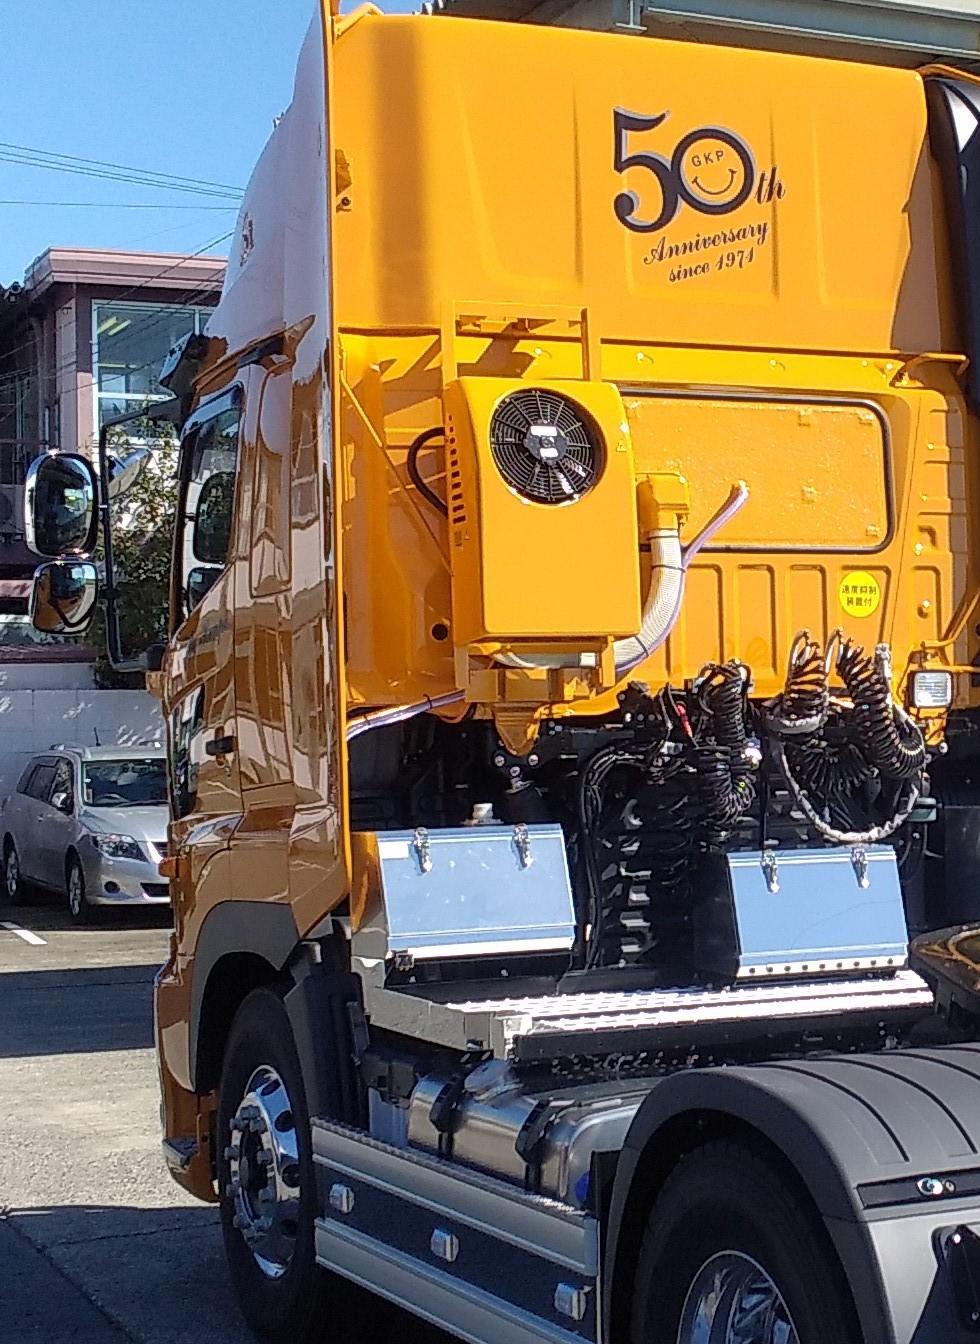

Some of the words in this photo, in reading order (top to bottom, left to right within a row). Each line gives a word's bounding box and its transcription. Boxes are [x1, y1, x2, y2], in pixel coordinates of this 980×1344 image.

[691, 150, 724, 167] GKP
[643, 222, 768, 265] Anniversary
[668, 261, 710, 283] since
[715, 246, 755, 271] 1971
